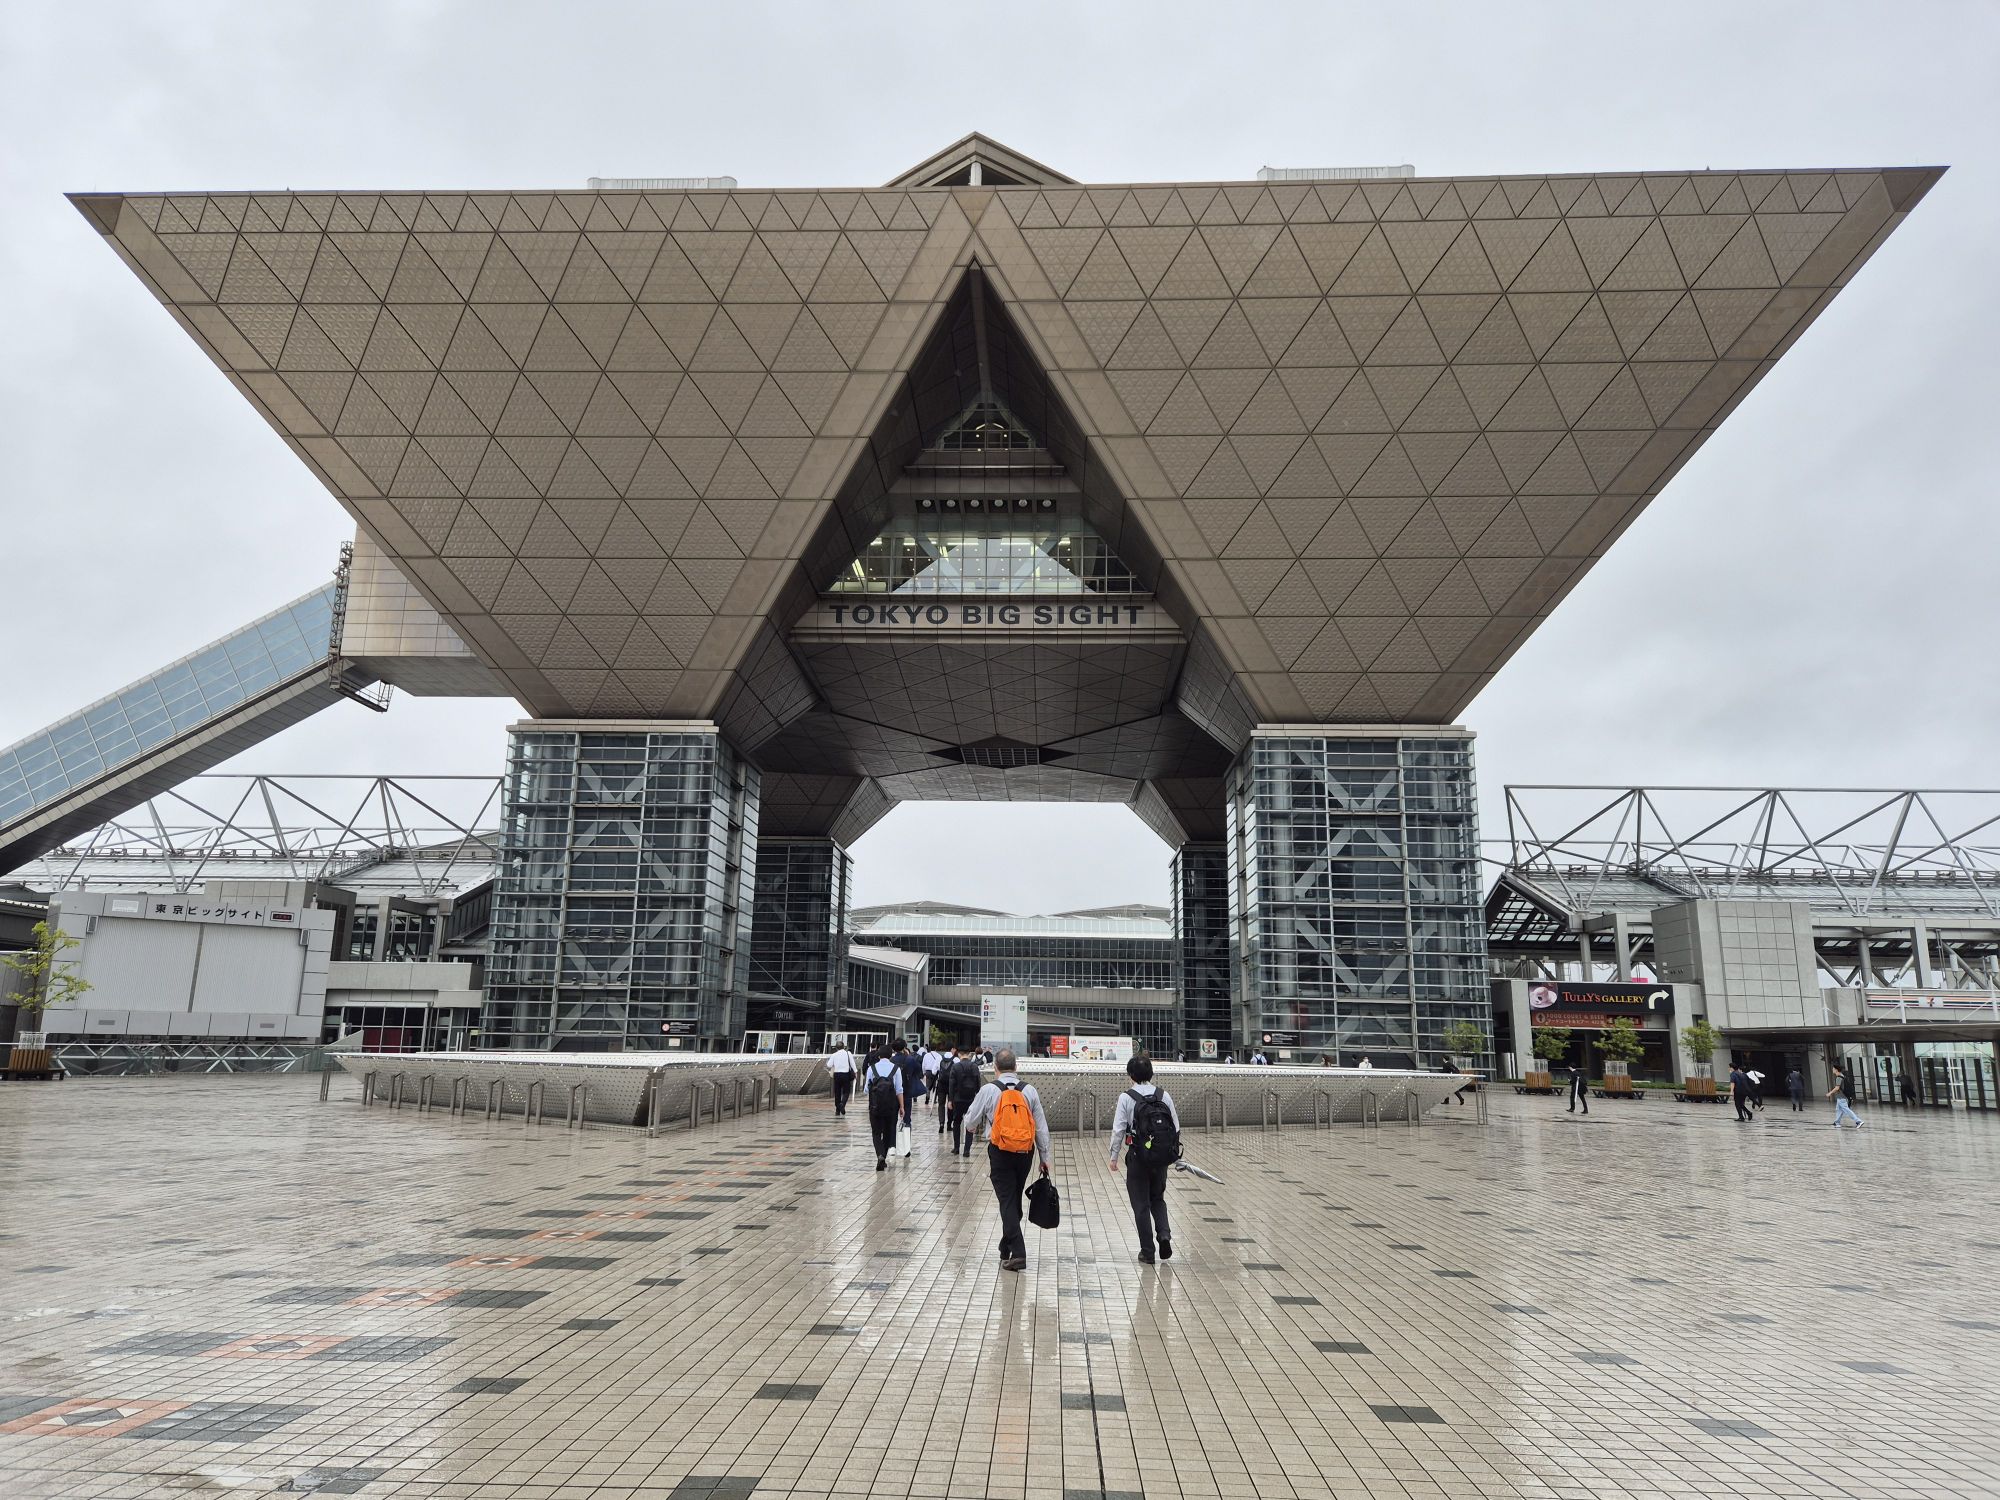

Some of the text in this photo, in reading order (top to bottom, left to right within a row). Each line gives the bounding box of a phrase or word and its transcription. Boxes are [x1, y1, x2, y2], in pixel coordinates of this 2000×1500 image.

[829, 605, 1145, 625] TOKYO BIG SIGHT
[155, 903, 263, 919] 東京ビッグサイト
[1562, 991, 1645, 1003] TULLY'S GALLERY
